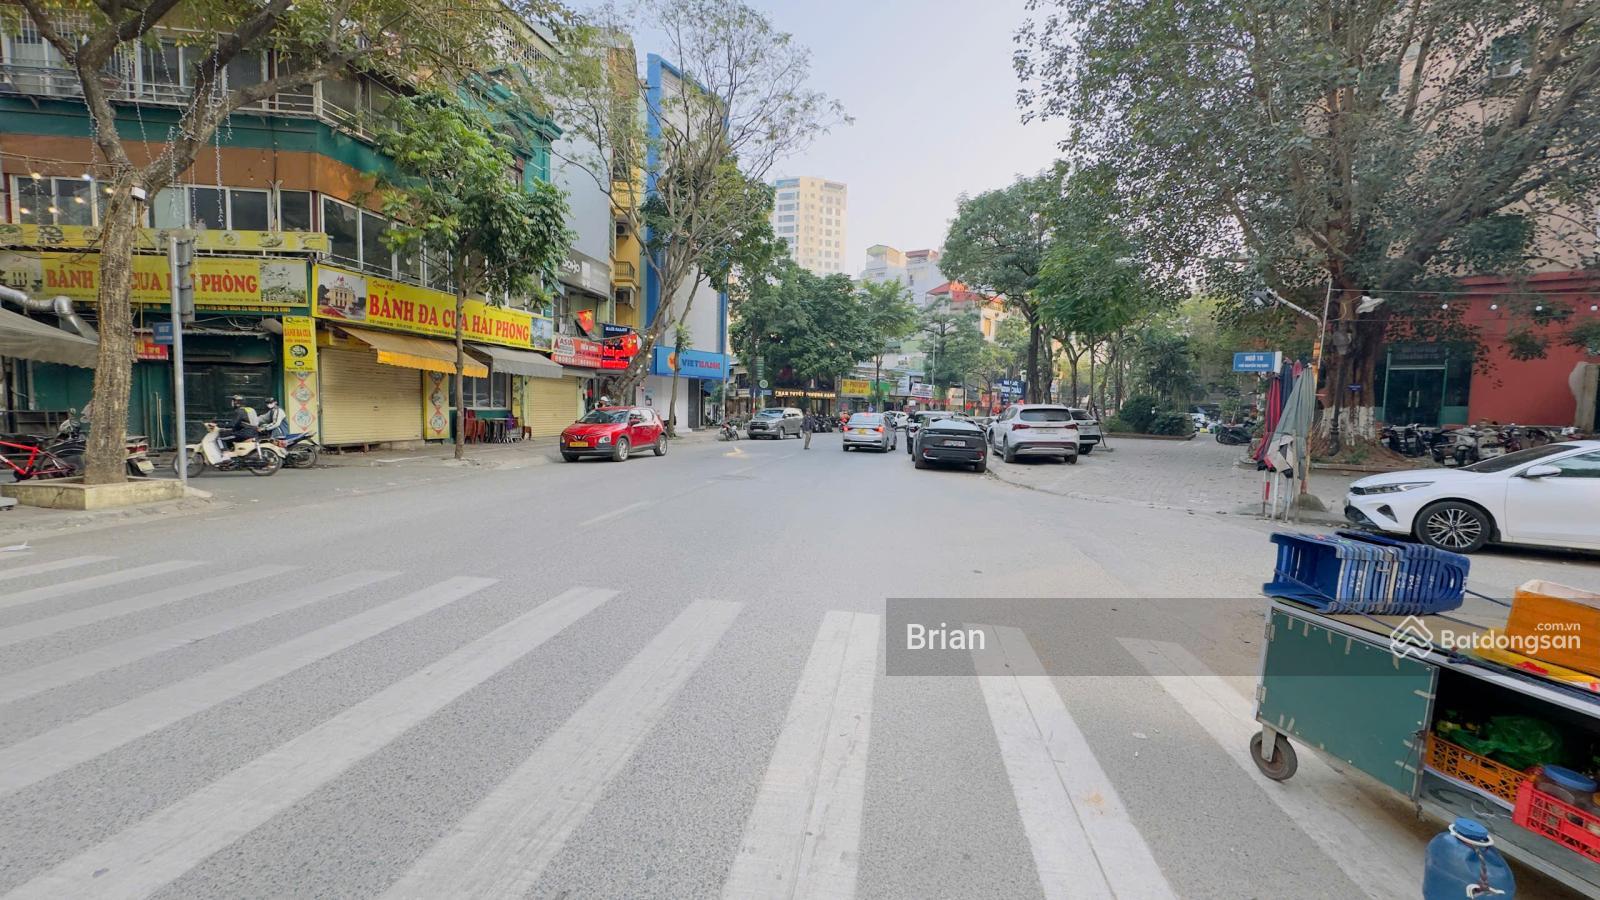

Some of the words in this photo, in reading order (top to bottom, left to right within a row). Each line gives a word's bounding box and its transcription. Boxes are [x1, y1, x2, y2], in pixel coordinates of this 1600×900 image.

[200, 269, 258, 293] PHÒNG
[369, 290, 415, 323] BÁNH
[418, 303, 439, 326] ĐA
[472, 309, 493, 335] HẢI
[496, 317, 529, 342] PHÒNG
